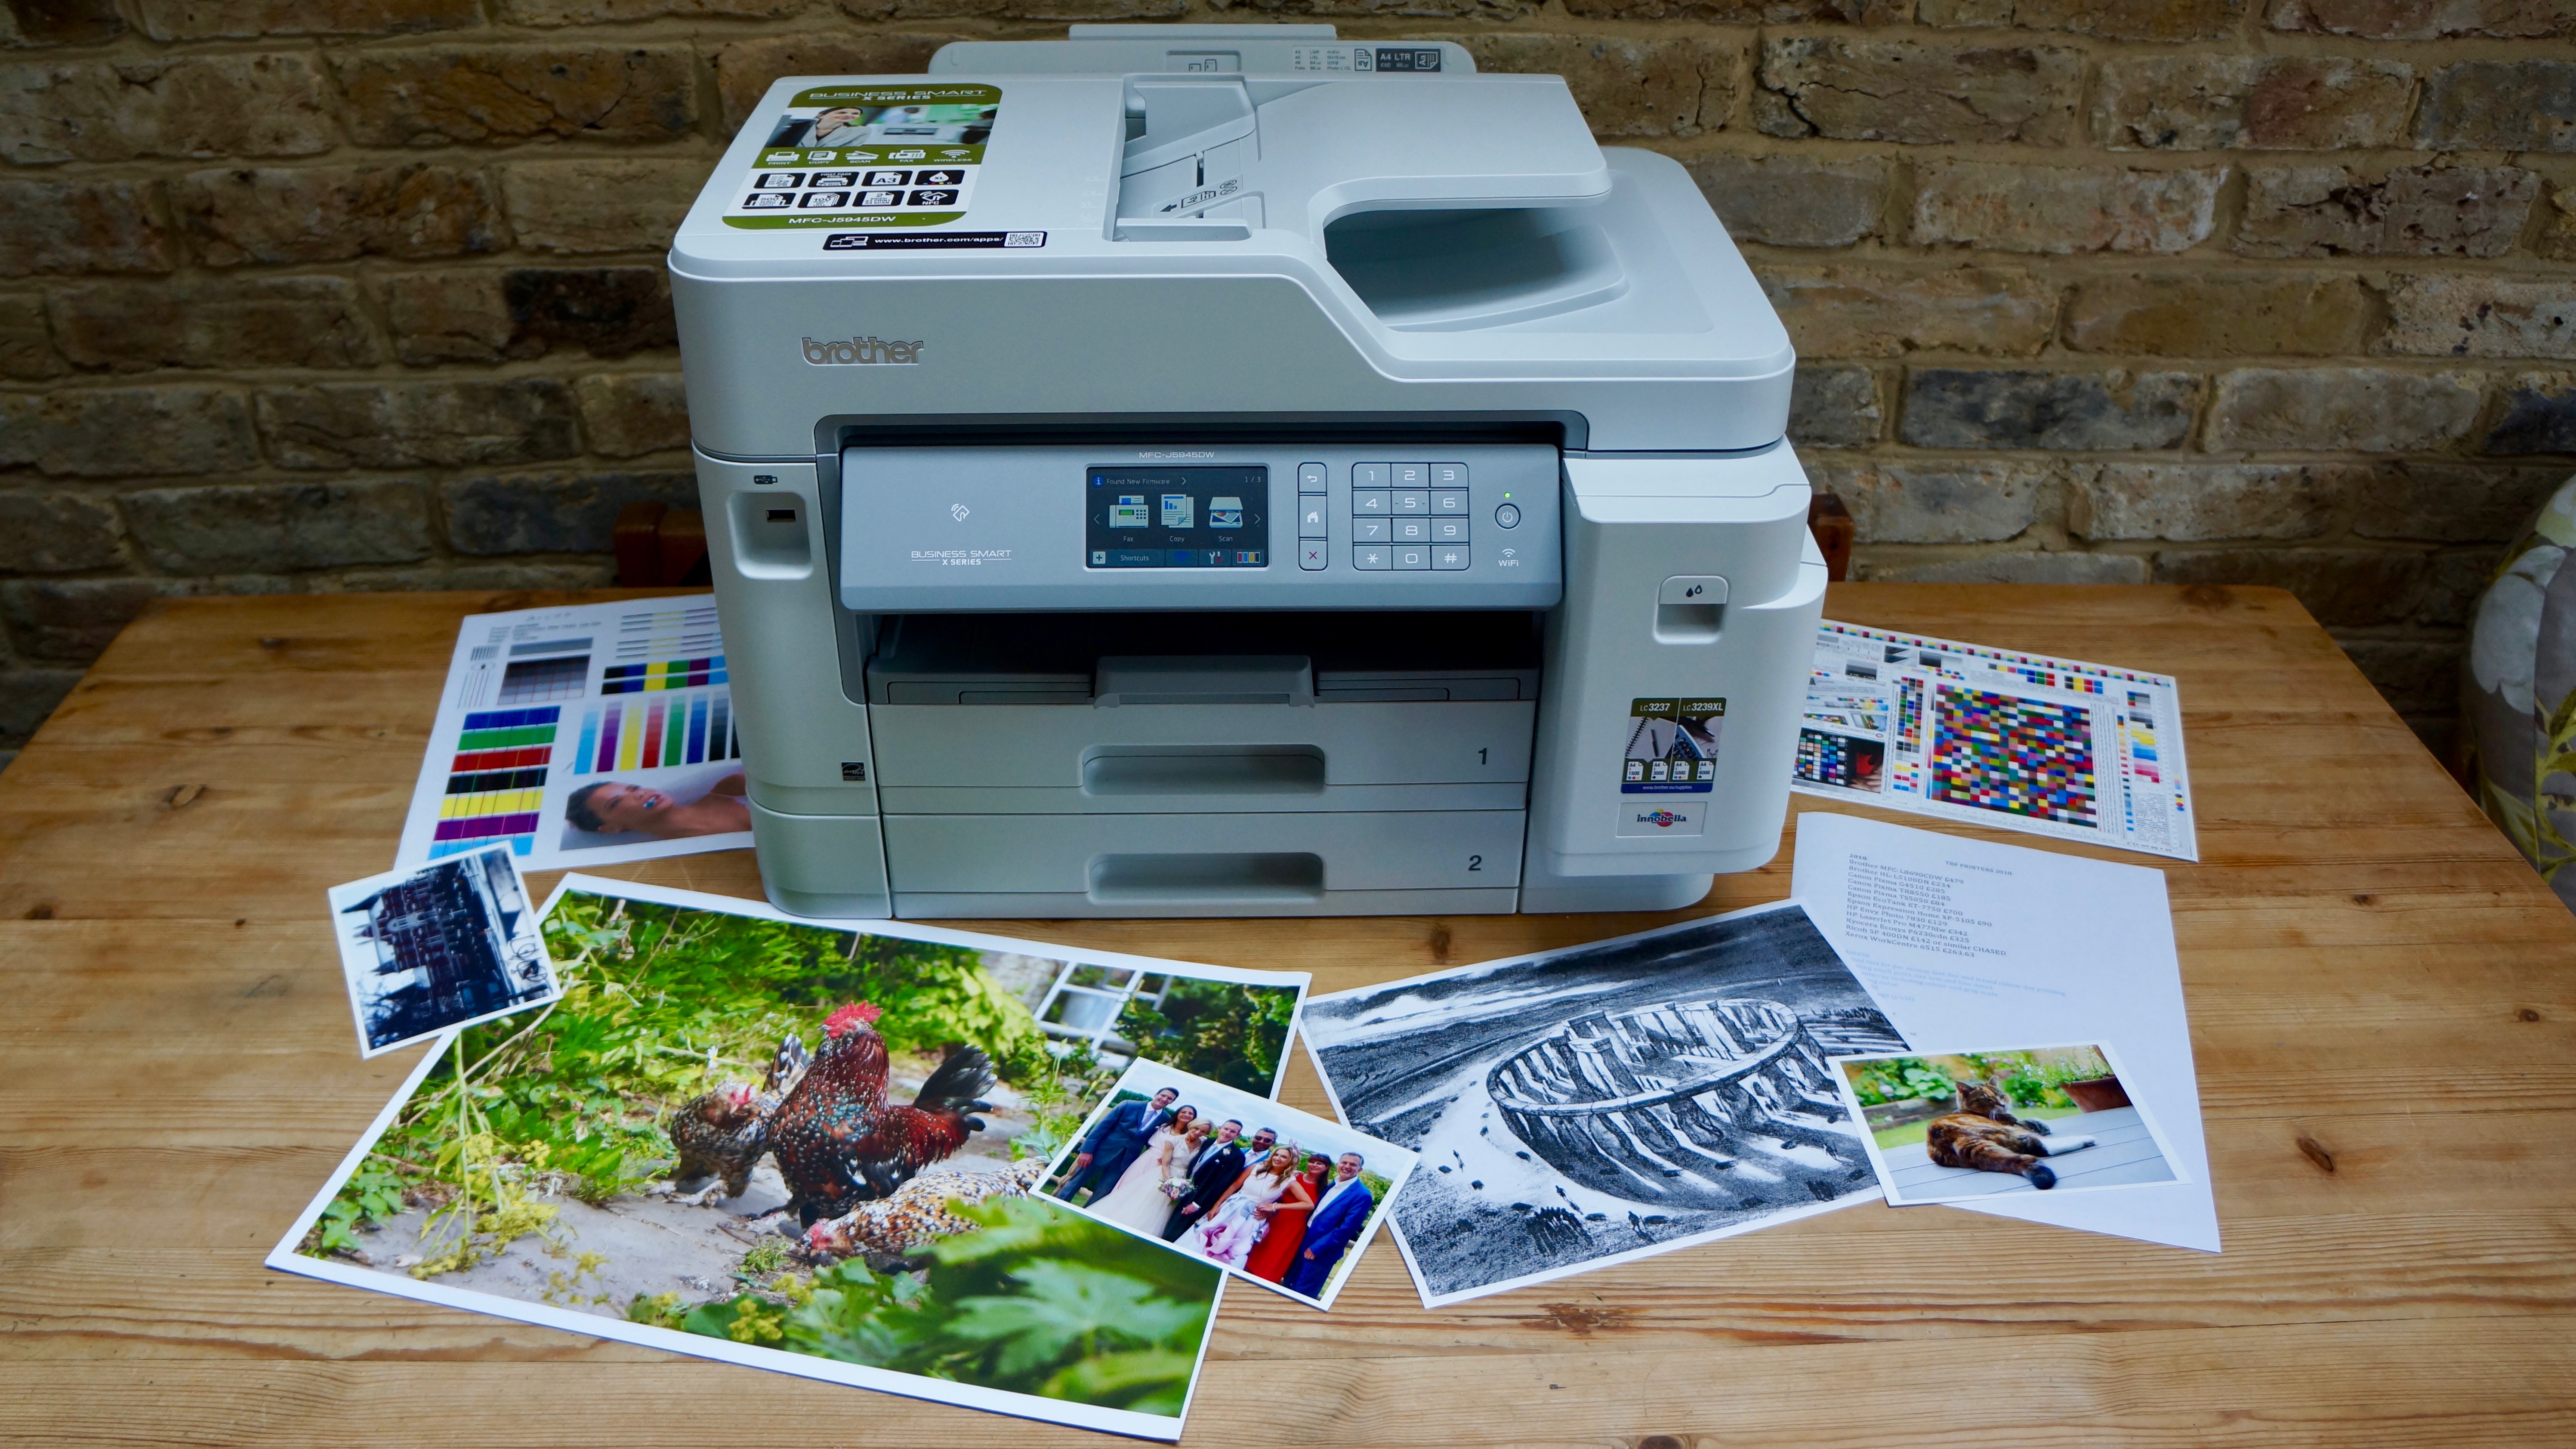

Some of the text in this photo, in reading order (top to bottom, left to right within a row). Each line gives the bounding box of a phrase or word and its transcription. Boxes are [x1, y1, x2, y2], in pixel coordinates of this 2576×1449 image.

[1394, 53, 1411, 61] LTR
[788, 216, 897, 224] MFC-J5945DW
[874, 236, 1004, 245] www.brother.com/apps/
[802, 337, 924, 365] brother
[1369, 470, 1454, 481] 1 2 3
[1365, 498, 1455, 508] 4 5 6
[1366, 525, 1456, 536] 7 8 9
[911, 550, 1012, 558] BUSINESS SMART
[1444, 553, 1457, 563] #
[1640, 703, 1671, 711] LC3237
[1683, 702, 1723, 711] LC3239XL
[1478, 748, 1488, 765] 1
[1637, 813, 1687, 822] innobella
[1468, 854, 1482, 871] 2
[1960, 863, 1993, 872] PRINTERS
[1849, 859, 1878, 868] Brother
[1880, 865, 1942, 880] MFC-L8690CDW
[1849, 865, 1878, 875] Brother
[1880, 871, 1929, 885] HL-L5100DN
[1848, 872, 1872, 881] Canon
[1874, 877, 1897, 885] Pixma
[1848, 878, 1871, 887] Canon
[1874, 883, 1897, 892] Pixma
[1899, 888, 1929, 898] TR8550
[1848, 885, 1871, 893] Canon
[1874, 890, 1897, 898] Pixma
[1899, 894, 1928, 904] TS5050
[1848, 891, 1871, 900] Epson
[1873, 896, 1906, 906] EcoTank
[1908, 902, 1941, 912] ET-7750
[1847, 897, 1870, 906] Epson
[1873, 903, 1915, 915] Expression
[1917, 910, 1940, 918] Home
[1942, 915, 1975, 924] XP-5105
[1860, 907, 1879, 915] Envy
[1881, 911, 1903, 919] Photo
[1846, 918, 1877, 928] Kyocera
[1880, 924, 1906, 933] Ecosys
[1908, 928, 1947, 940] P6230cdn
[1860, 913, 1891, 924] LaserJet
[1909, 922, 1946, 933] M477fdw
[1845, 931, 1868, 940] Xerox
[1870, 935, 1918, 948] WorkCentre
[1942, 947, 1974, 957] £263.63
[1846, 924, 1867, 933] Ricoh
[1881, 931, 1908, 940] 400DN
[1943, 942, 1971, 950] similar
[1973, 946, 2006, 955] CHASED
